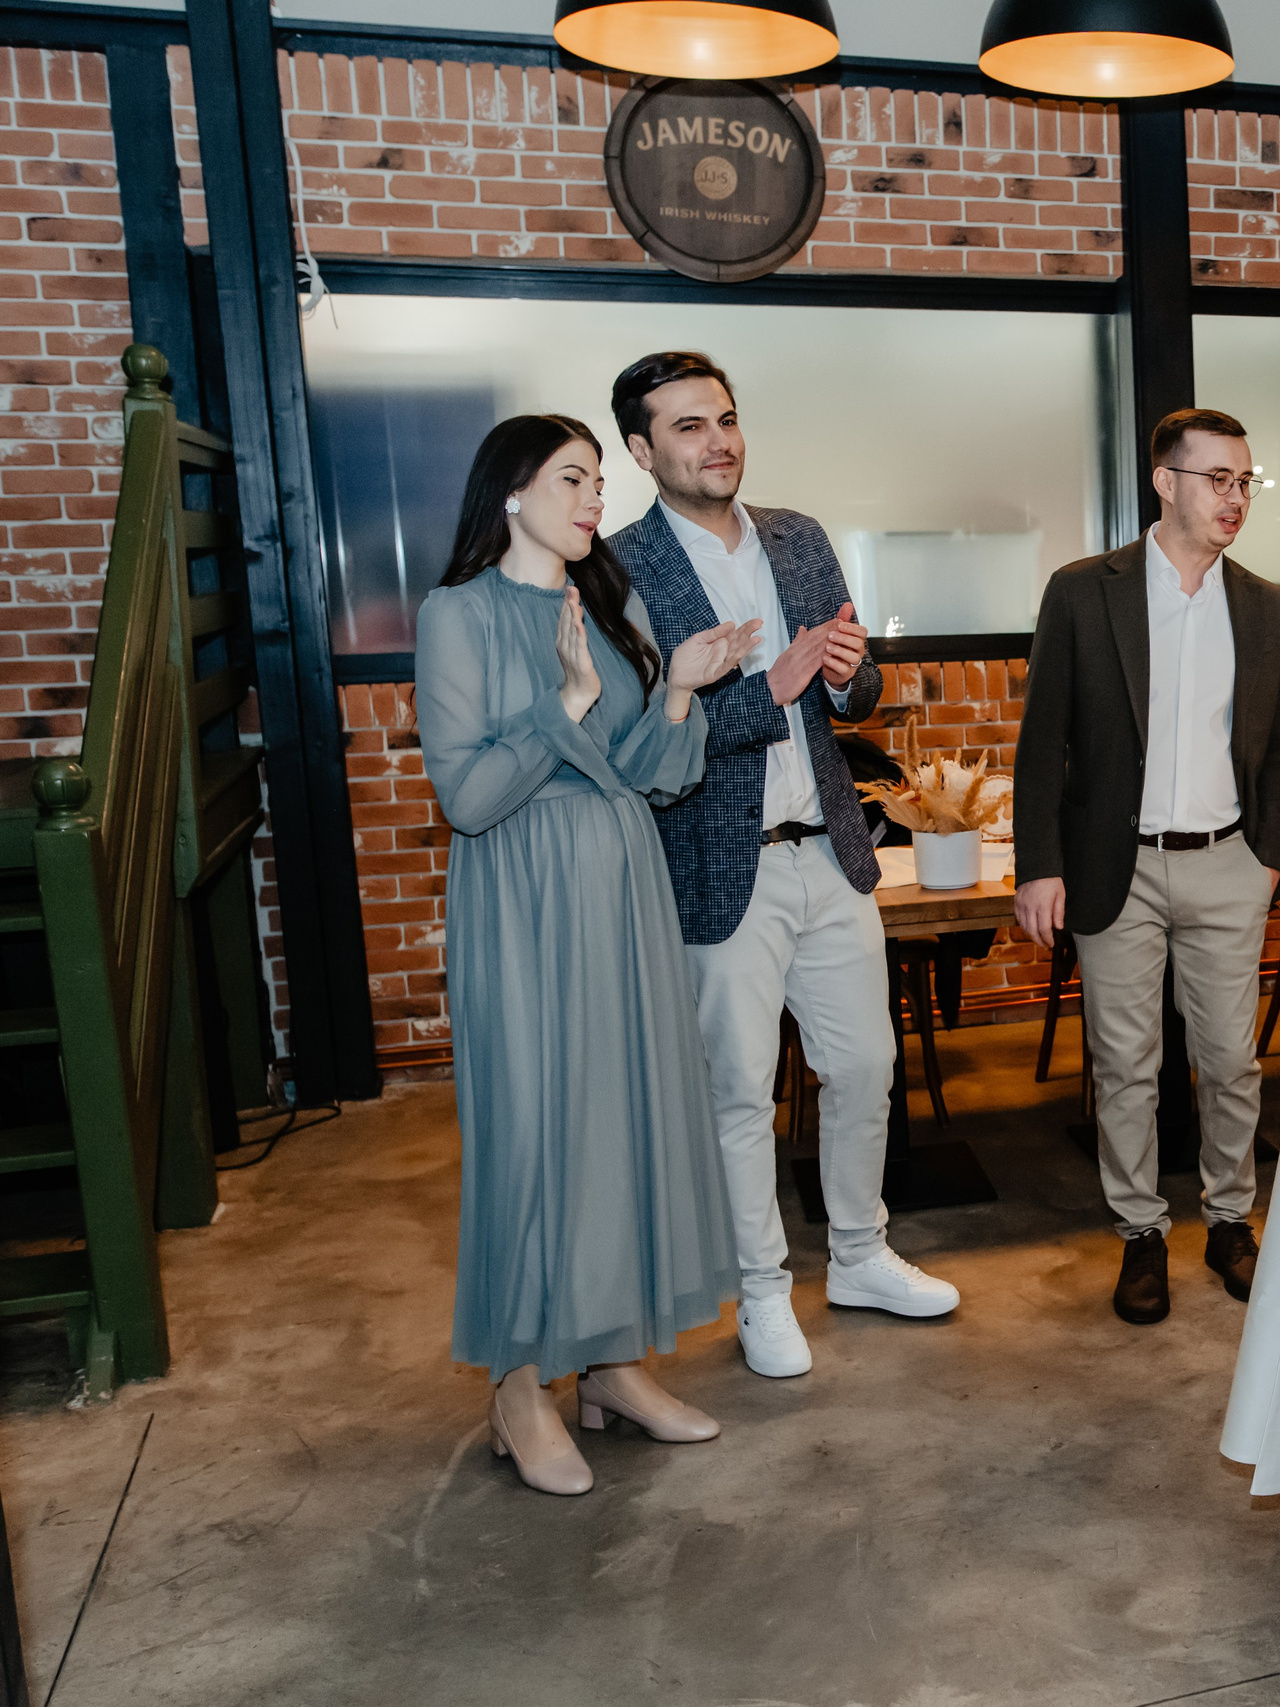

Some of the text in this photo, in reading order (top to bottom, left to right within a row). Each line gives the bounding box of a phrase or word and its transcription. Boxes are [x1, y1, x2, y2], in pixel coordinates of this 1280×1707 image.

[636, 116, 792, 164] JAMESON
[660, 206, 770, 226] IRISH WHISKEY
